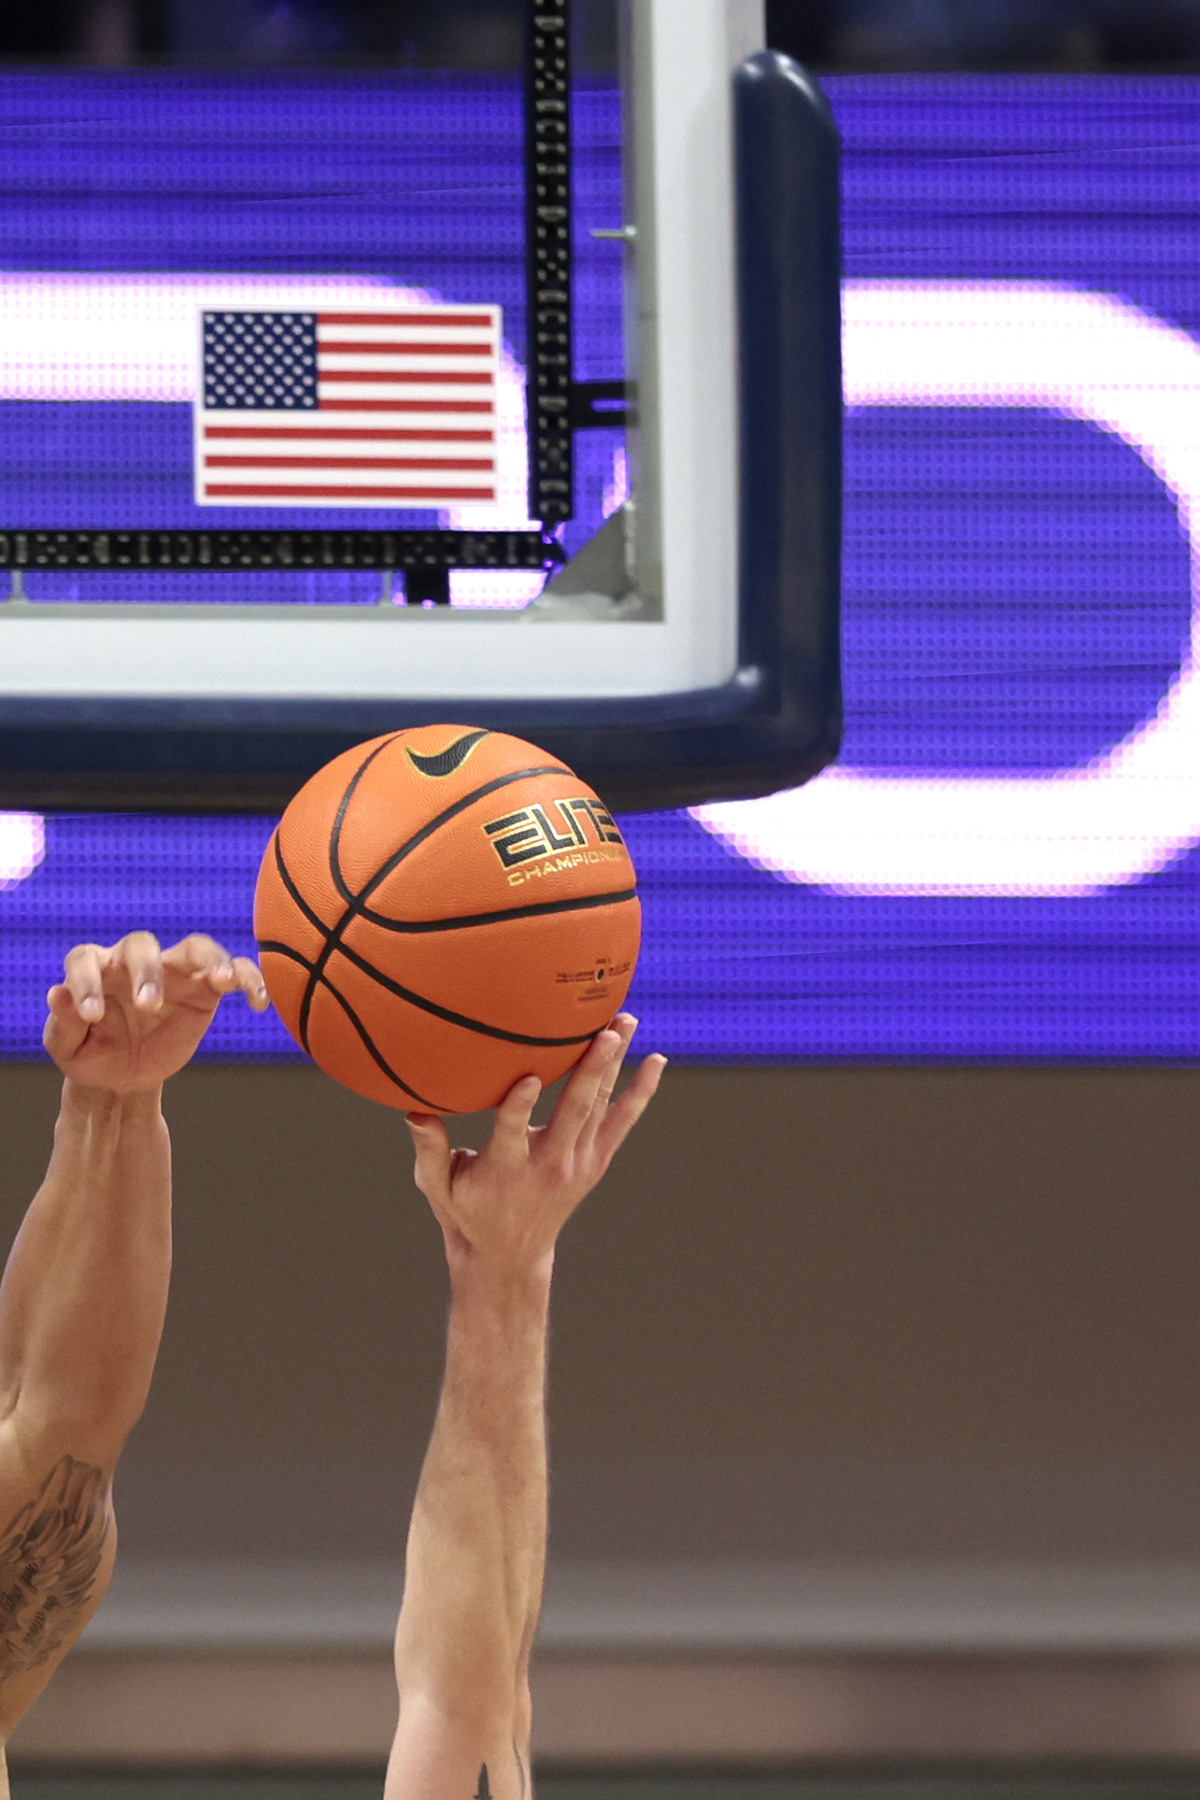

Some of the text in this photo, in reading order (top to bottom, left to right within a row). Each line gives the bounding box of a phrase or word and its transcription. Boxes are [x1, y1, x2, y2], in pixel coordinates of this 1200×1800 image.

[480, 797, 626, 871] ELITE
[506, 849, 623, 886] CHAMPION
[20, 1562, 39, 1595] you
